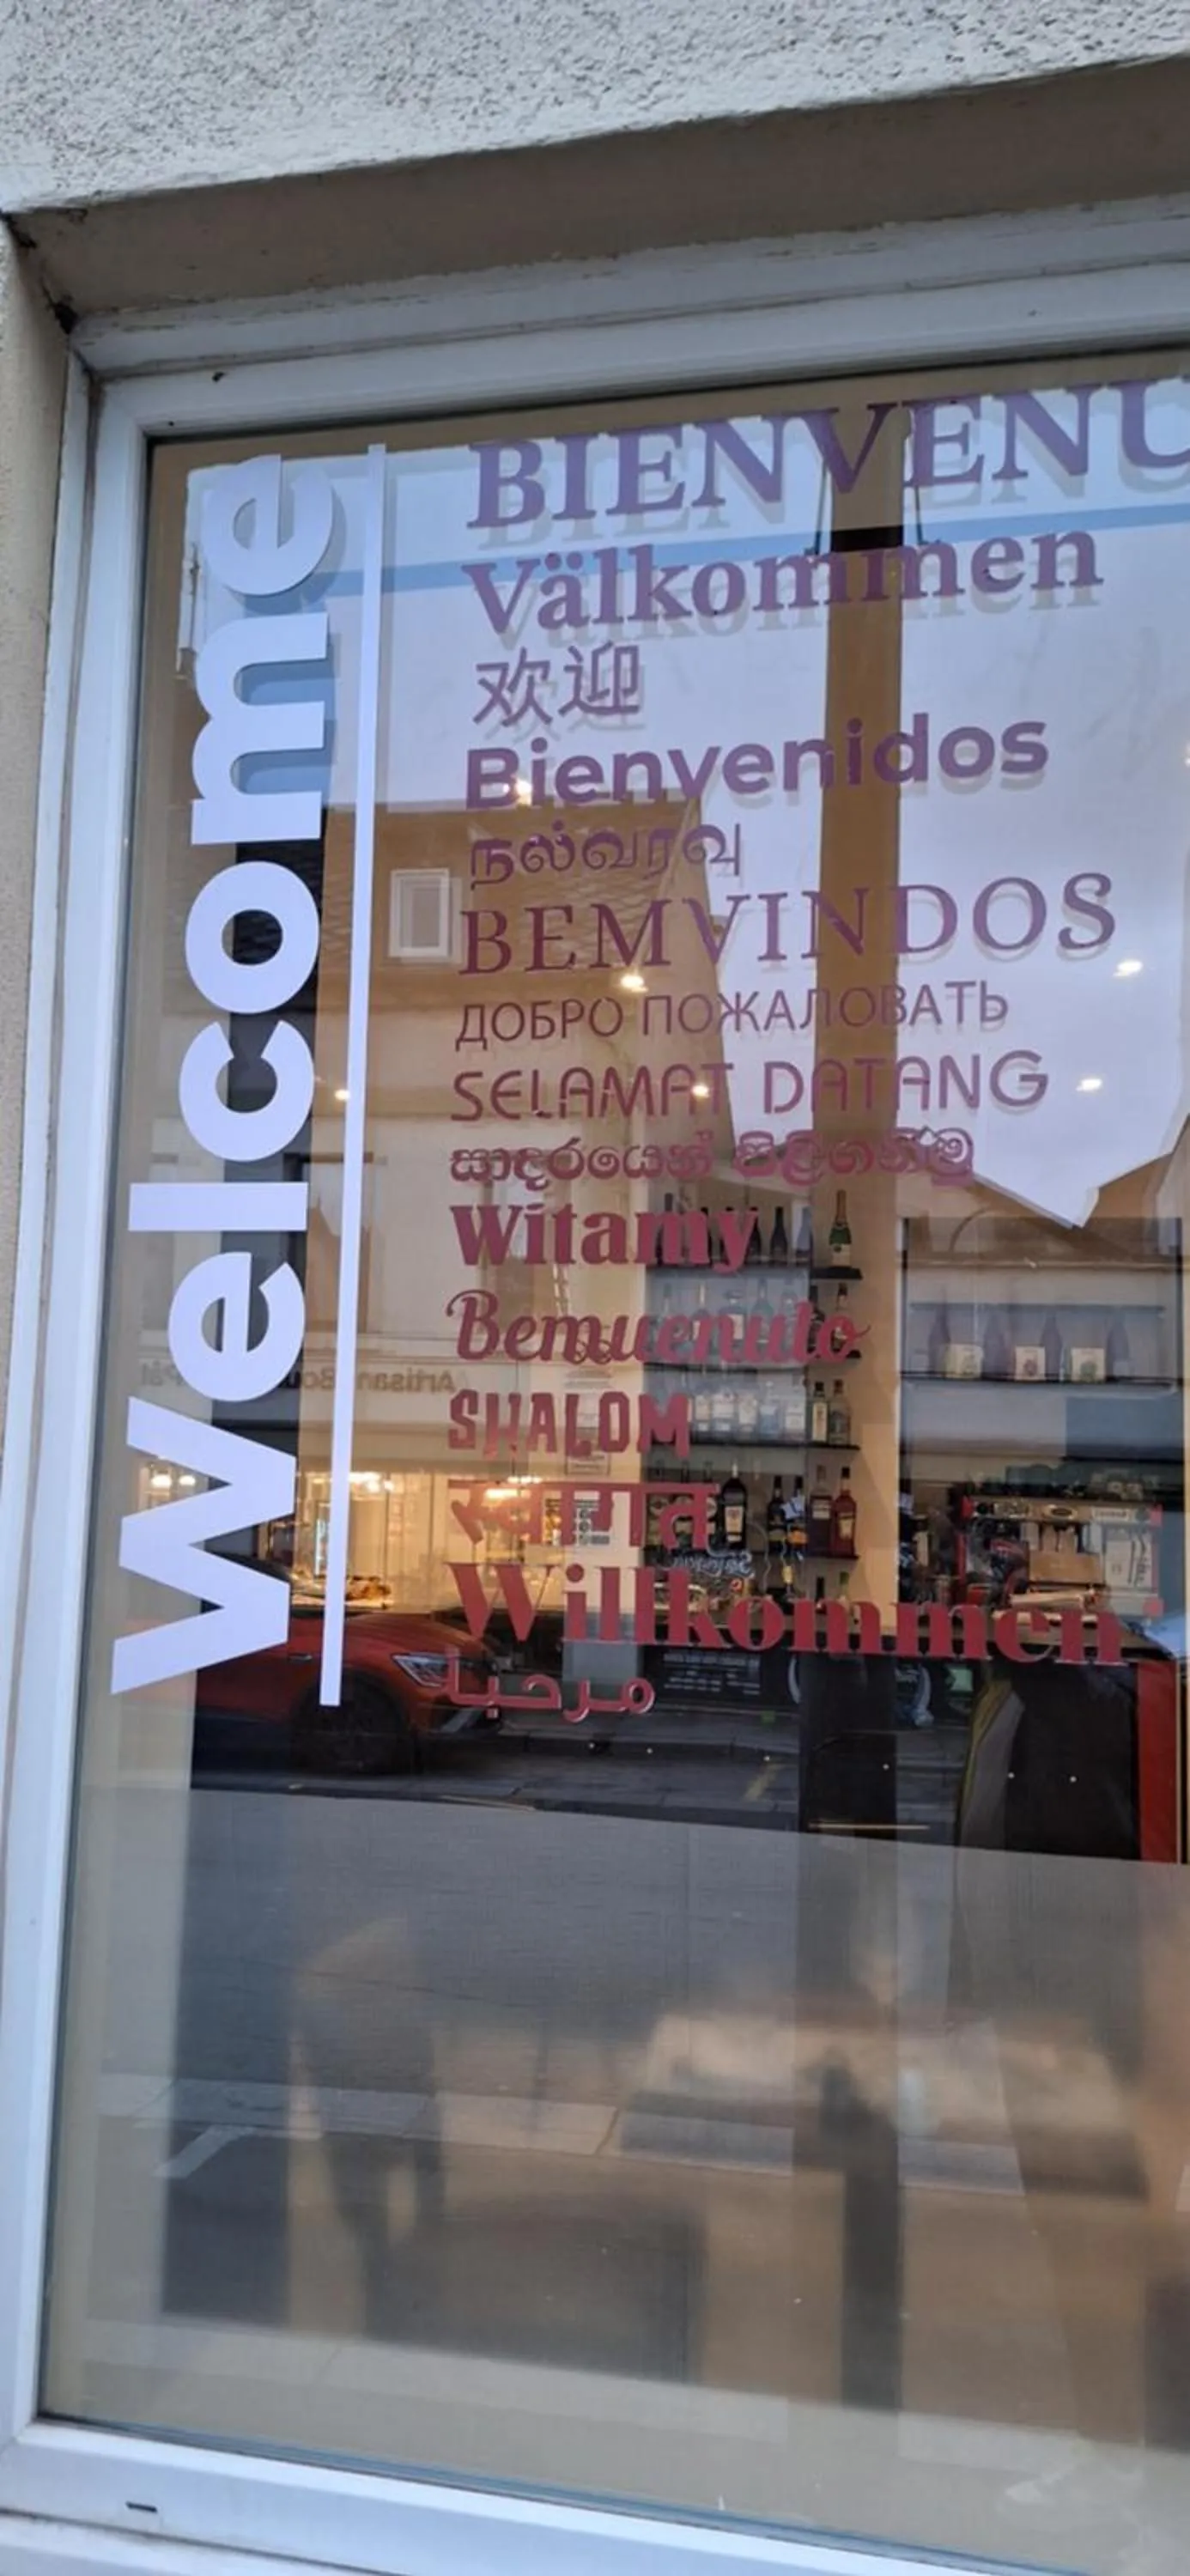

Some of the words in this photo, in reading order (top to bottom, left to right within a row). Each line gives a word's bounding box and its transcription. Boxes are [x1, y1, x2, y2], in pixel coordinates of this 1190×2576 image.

[466, 379, 1190, 529] BIENVENU
[461, 527, 1104, 634] Välkommen
[472, 641, 641, 726] 欢迎
[464, 712, 1049, 810] Bienvenidos
[470, 819, 741, 890] நல்வரவு
[458, 872, 1117, 975] BEMVINDOS
[454, 996, 624, 1051] ДОБРО
[641, 980, 1009, 1036] ПОЖАЛОВАТЬ
[110, 453, 335, 1695] Welcome
[450, 1061, 734, 1123] SELAMAT
[762, 1049, 1049, 1115] DATANG
[450, 1203, 759, 1274] Witamy
[447, 1388, 691, 1458] SHALOM
[444, 1561, 1129, 1668] Willkommen
[441, 1643, 656, 1723] مرحبا
